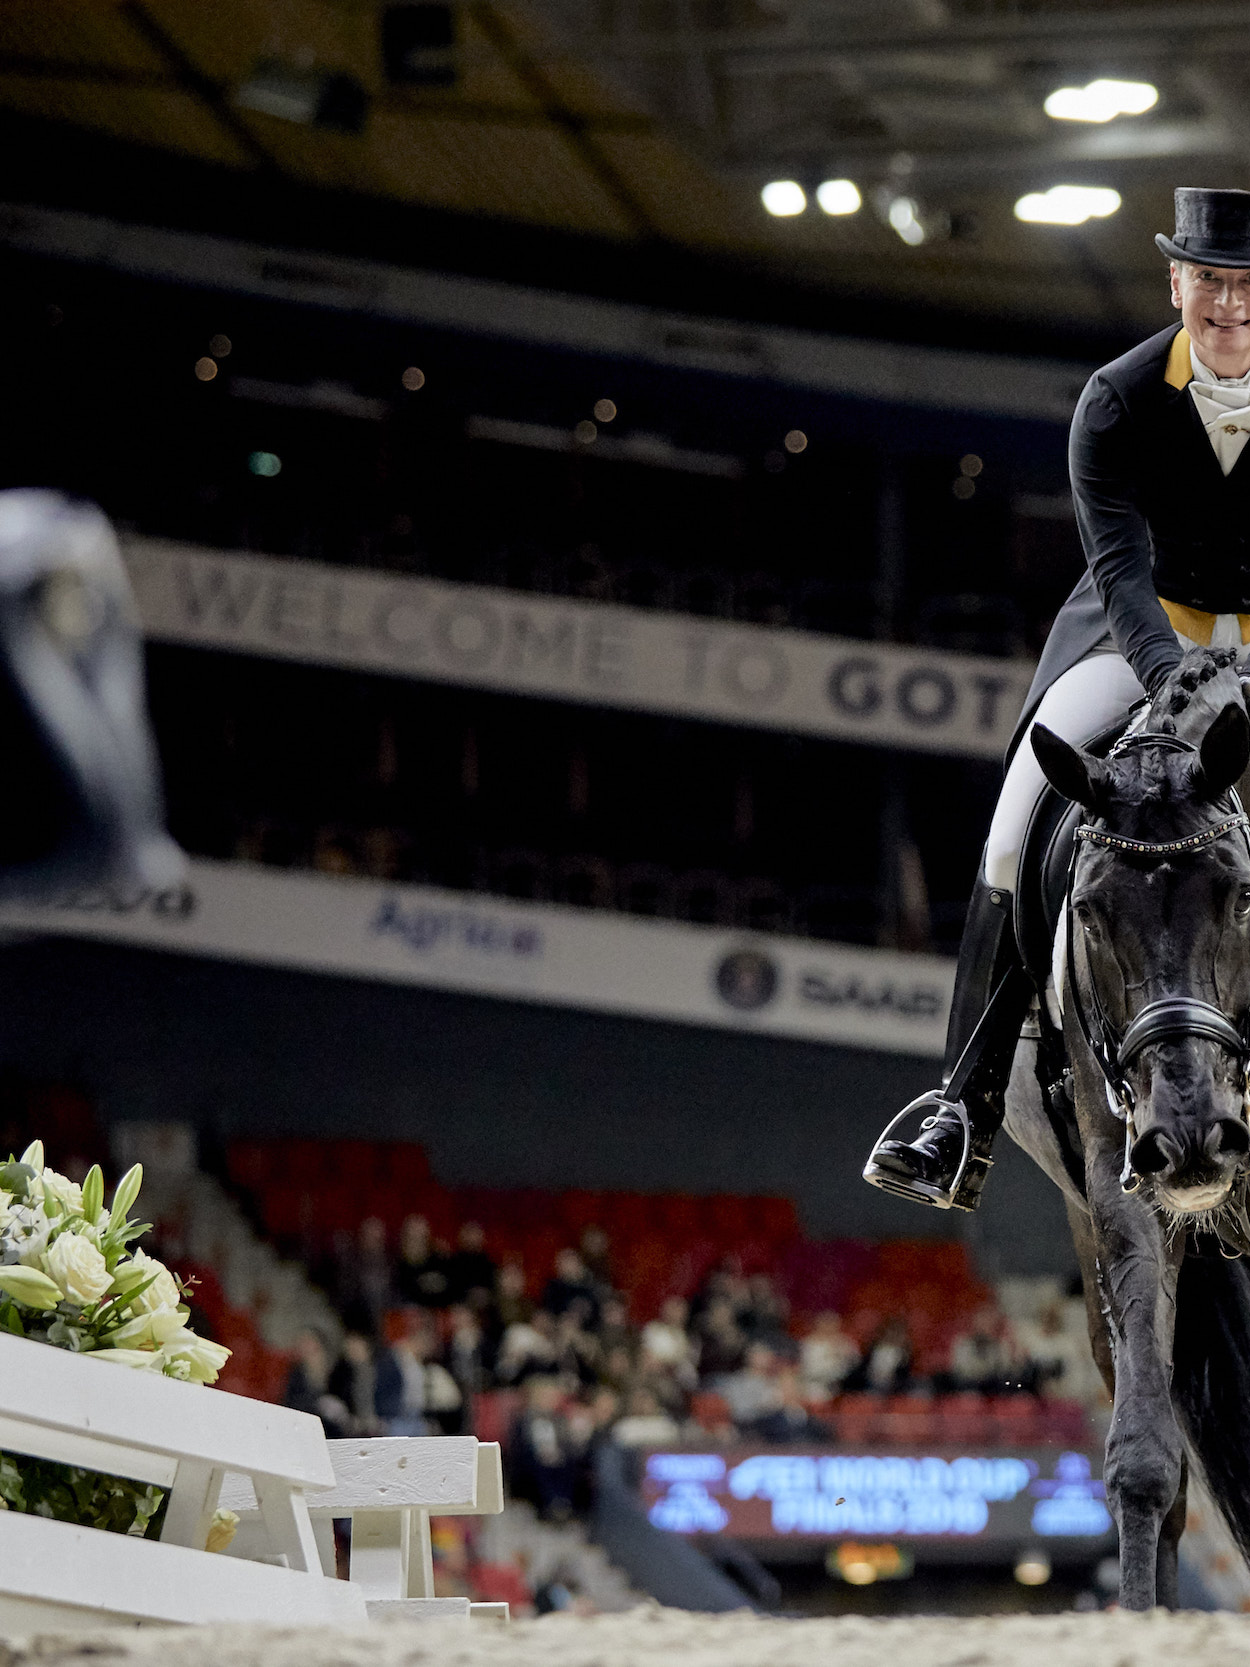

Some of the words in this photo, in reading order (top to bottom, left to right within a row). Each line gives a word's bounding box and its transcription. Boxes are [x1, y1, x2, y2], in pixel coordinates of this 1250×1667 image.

[173, 558, 634, 688] WELCOME
[679, 630, 793, 711] TO
[826, 656, 1012, 734] GOT
[799, 967, 946, 1018] SAAB
